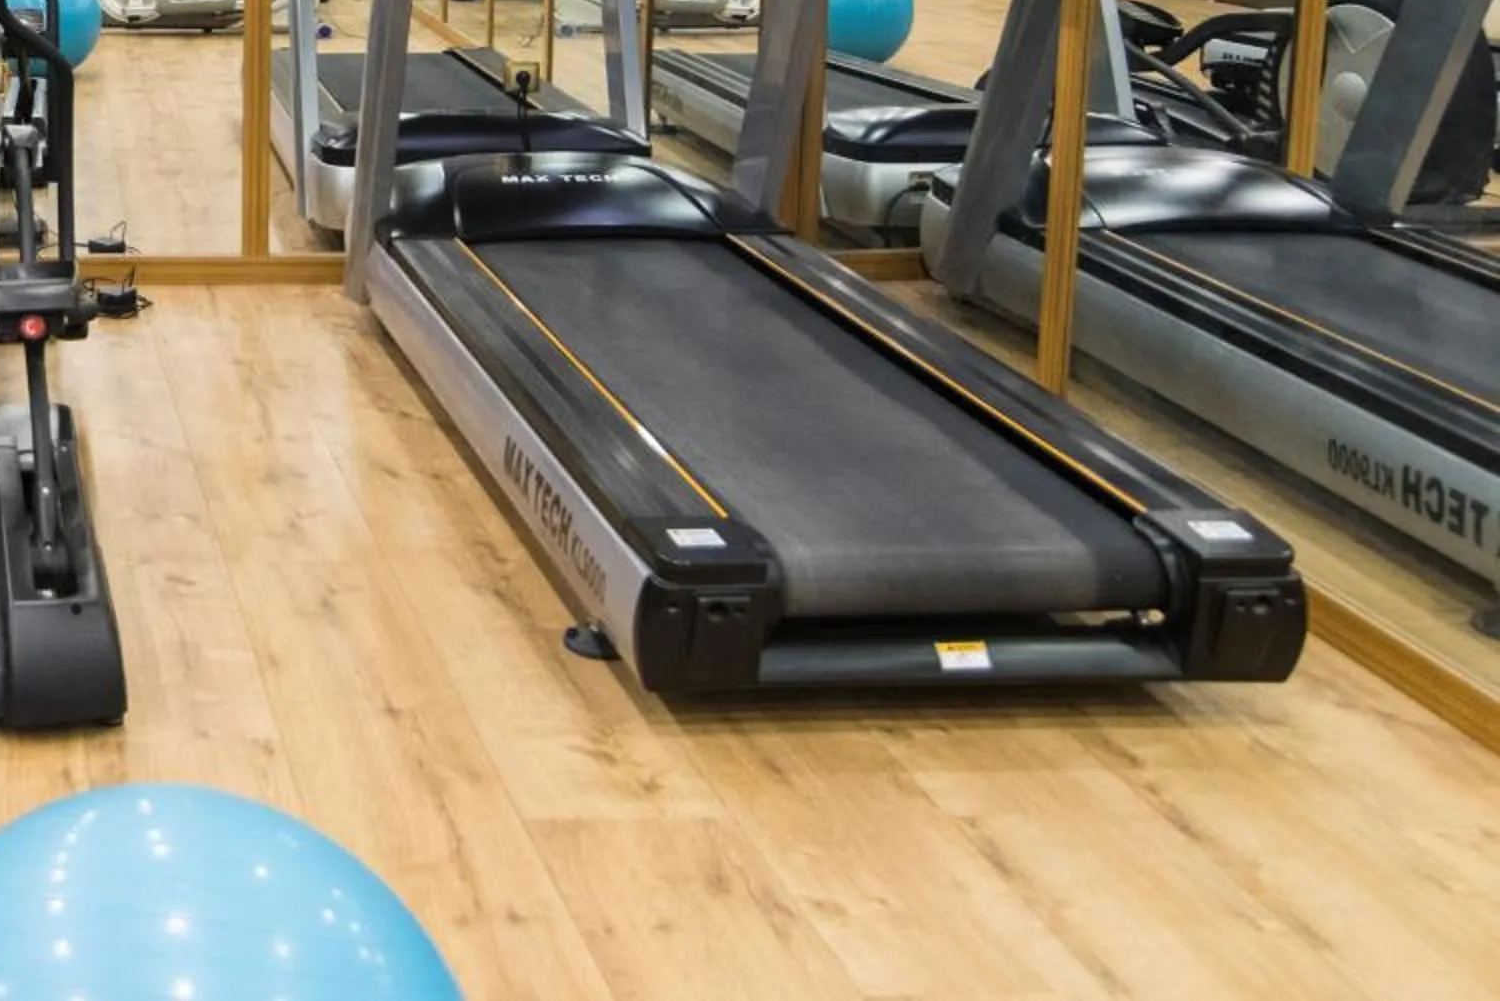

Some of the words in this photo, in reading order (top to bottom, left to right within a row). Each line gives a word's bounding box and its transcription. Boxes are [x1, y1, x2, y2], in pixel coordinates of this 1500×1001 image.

[501, 174, 549, 184] MAX
[559, 174, 615, 183] TECH
[504, 436, 535, 503] MAX
[534, 470, 573, 555] TECH
